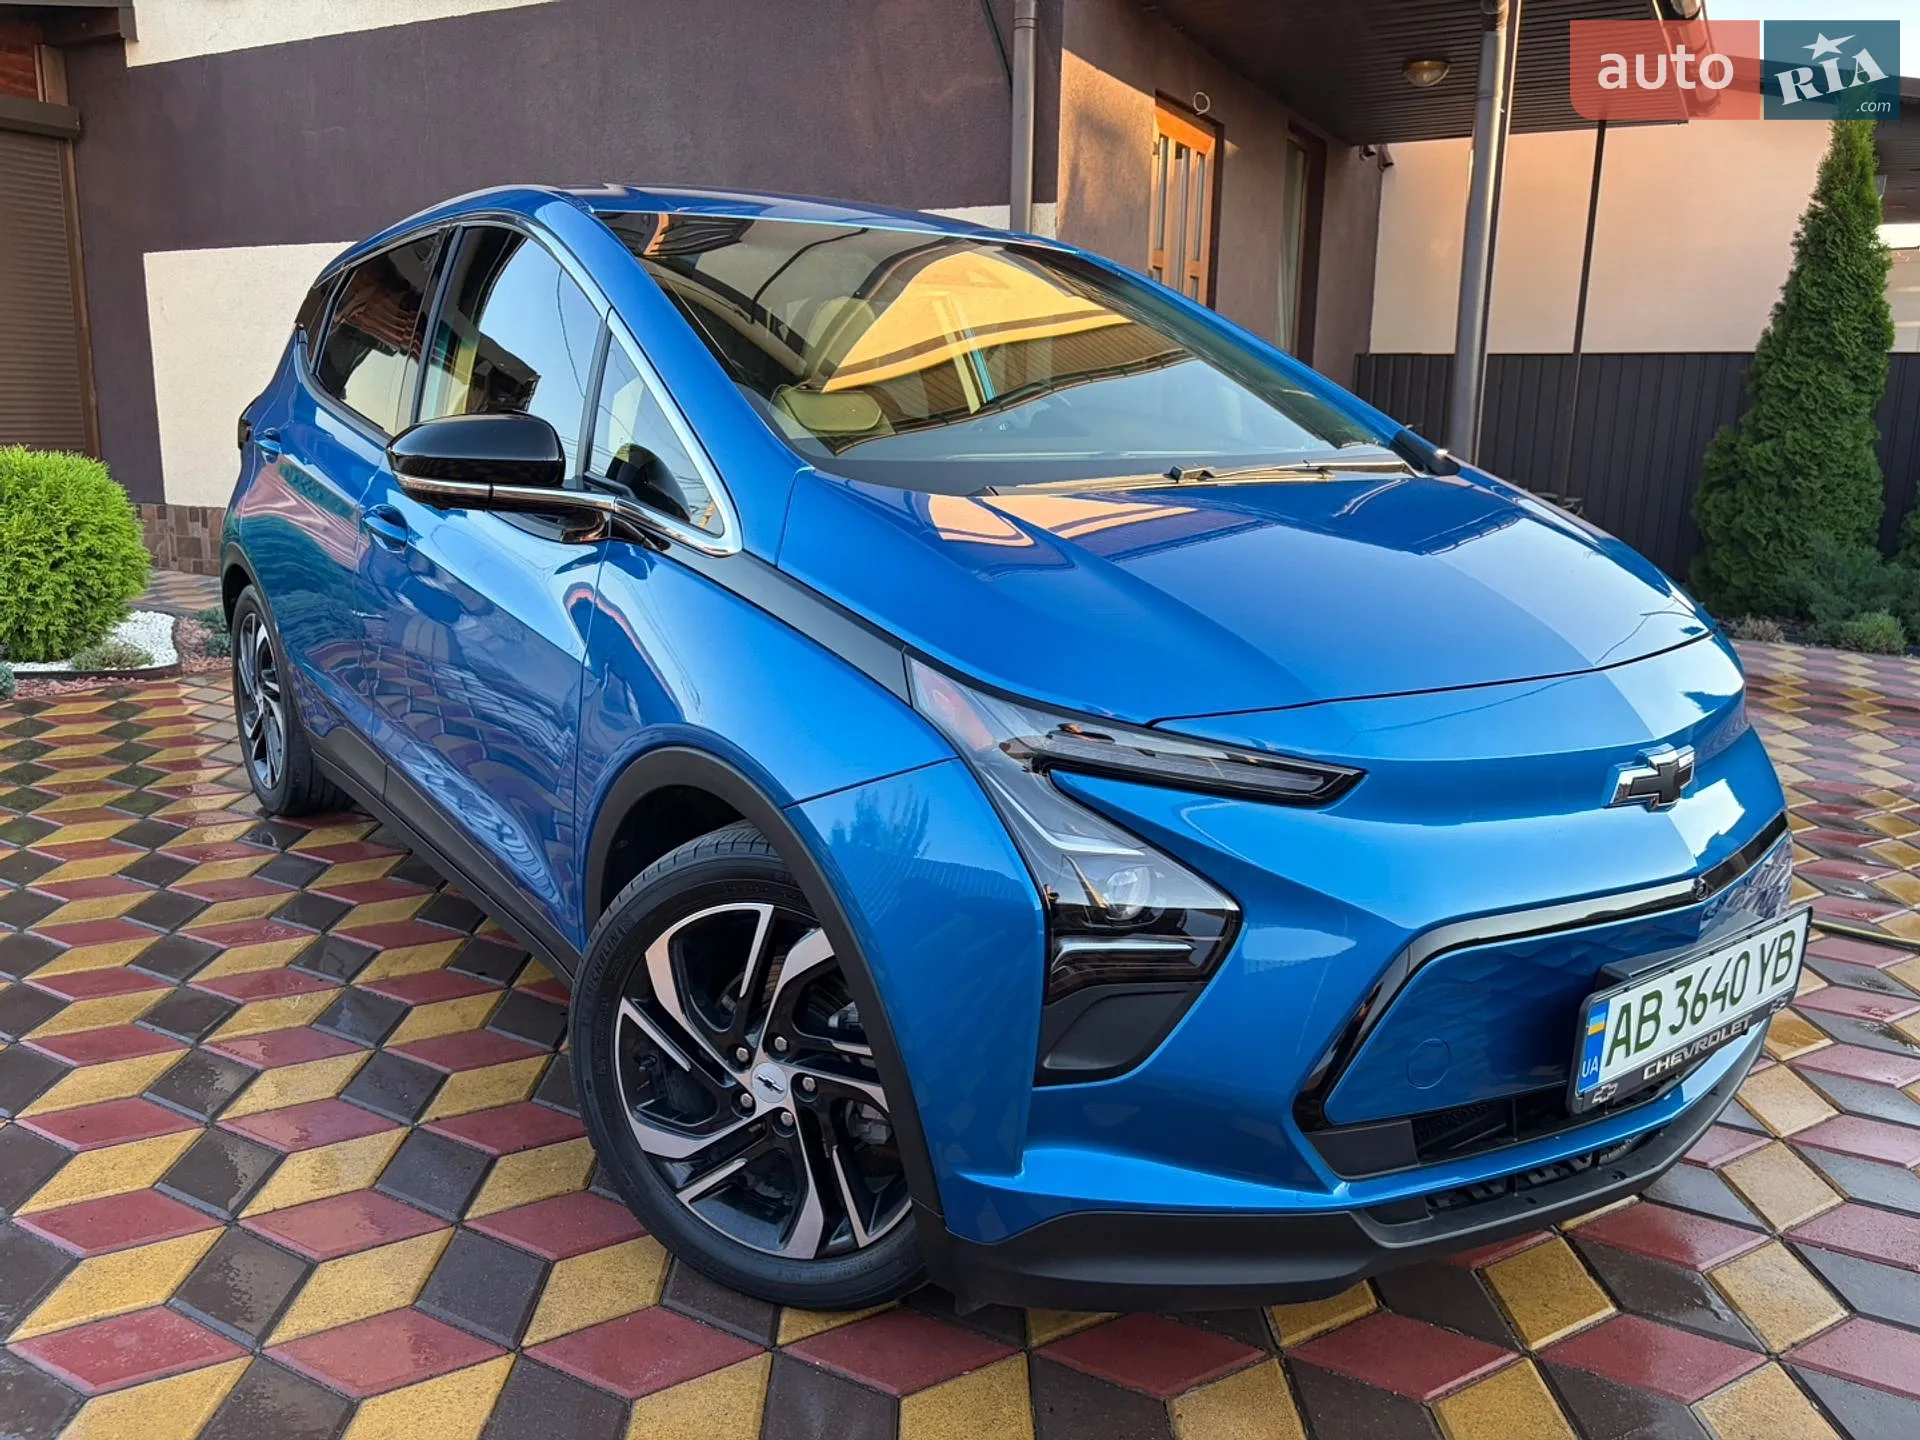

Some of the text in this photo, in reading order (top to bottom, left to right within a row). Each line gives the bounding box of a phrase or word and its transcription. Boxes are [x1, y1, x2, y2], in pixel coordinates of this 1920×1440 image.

[1605, 929, 1796, 1067] AB 3640 YB
[1581, 1058, 1599, 1079] UA
[1643, 1018, 1750, 1080] CHEVROLET
